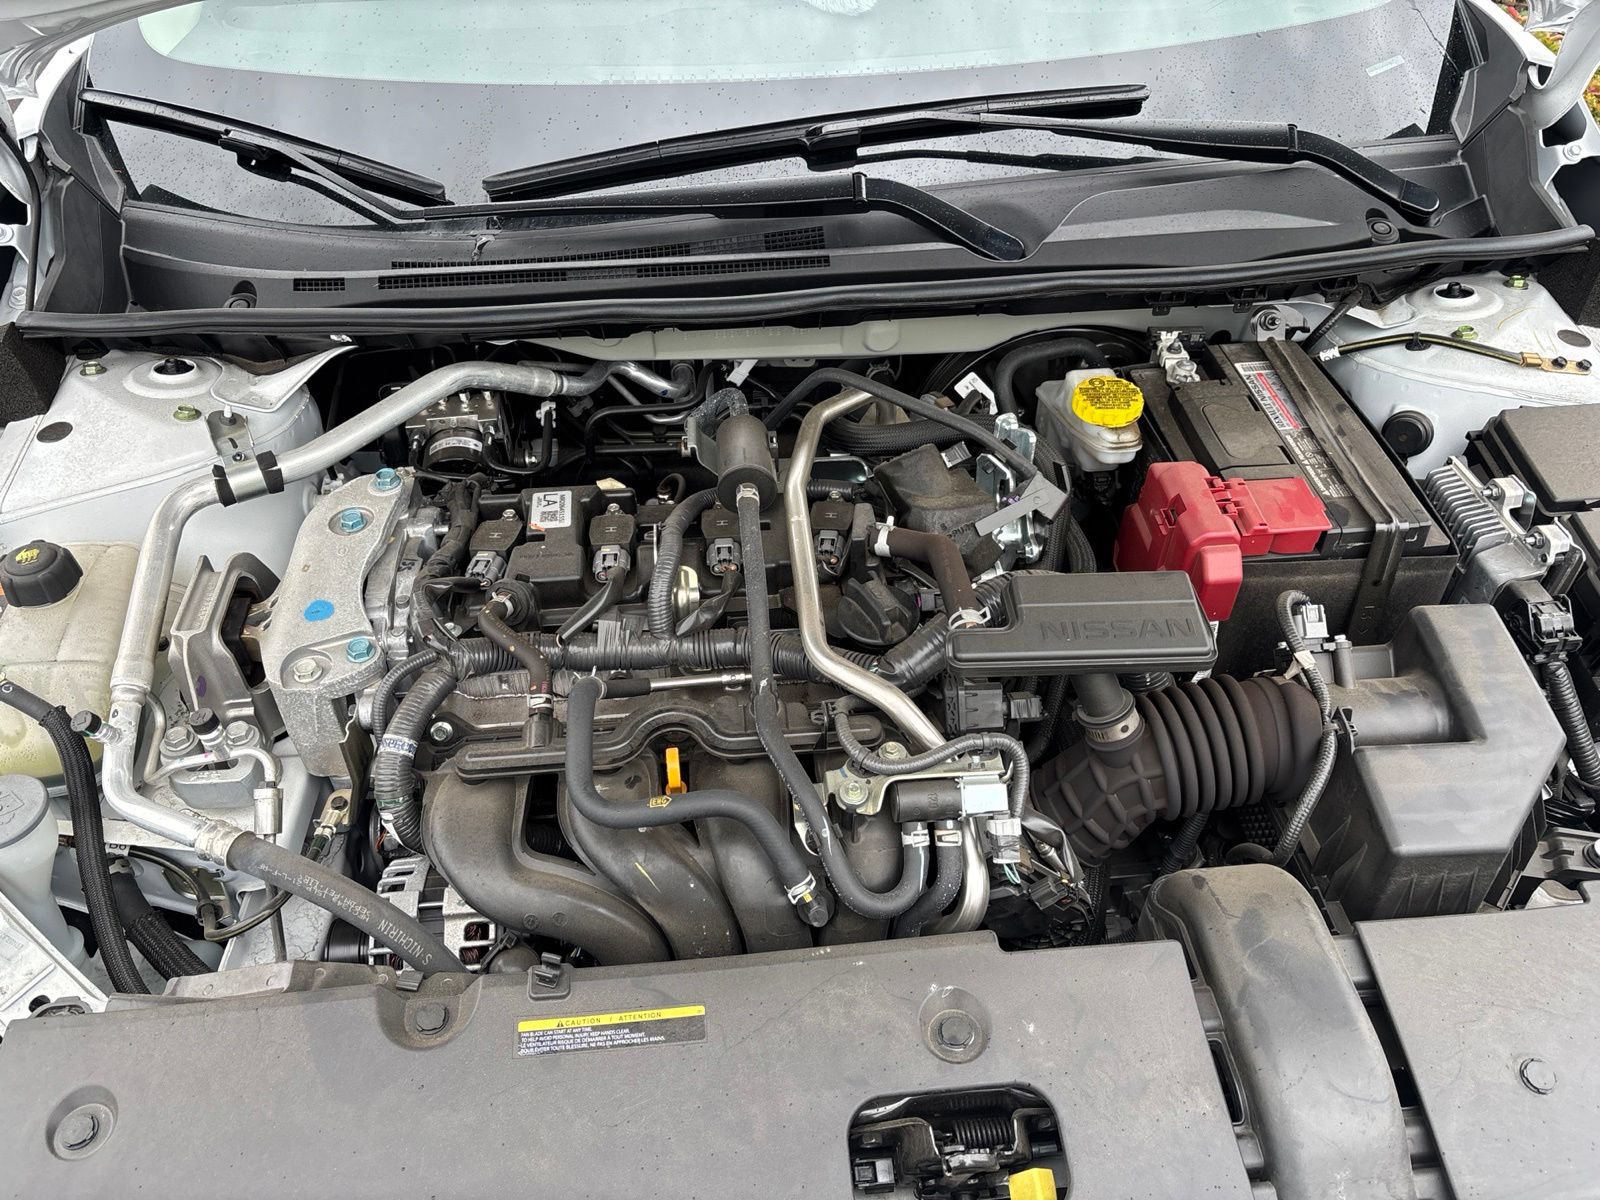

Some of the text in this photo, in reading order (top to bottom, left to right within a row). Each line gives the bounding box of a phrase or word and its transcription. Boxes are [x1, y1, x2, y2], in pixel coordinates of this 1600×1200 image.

[542, 493, 558, 508] LA
[1039, 617, 1196, 641] NISSAN
[565, 1017, 601, 1027] CAUTION
[618, 1011, 662, 1022] ATTENTION
[527, 1040, 557, 1048] VENTILATEUR
[613, 1037, 640, 1045] APPROCHER
